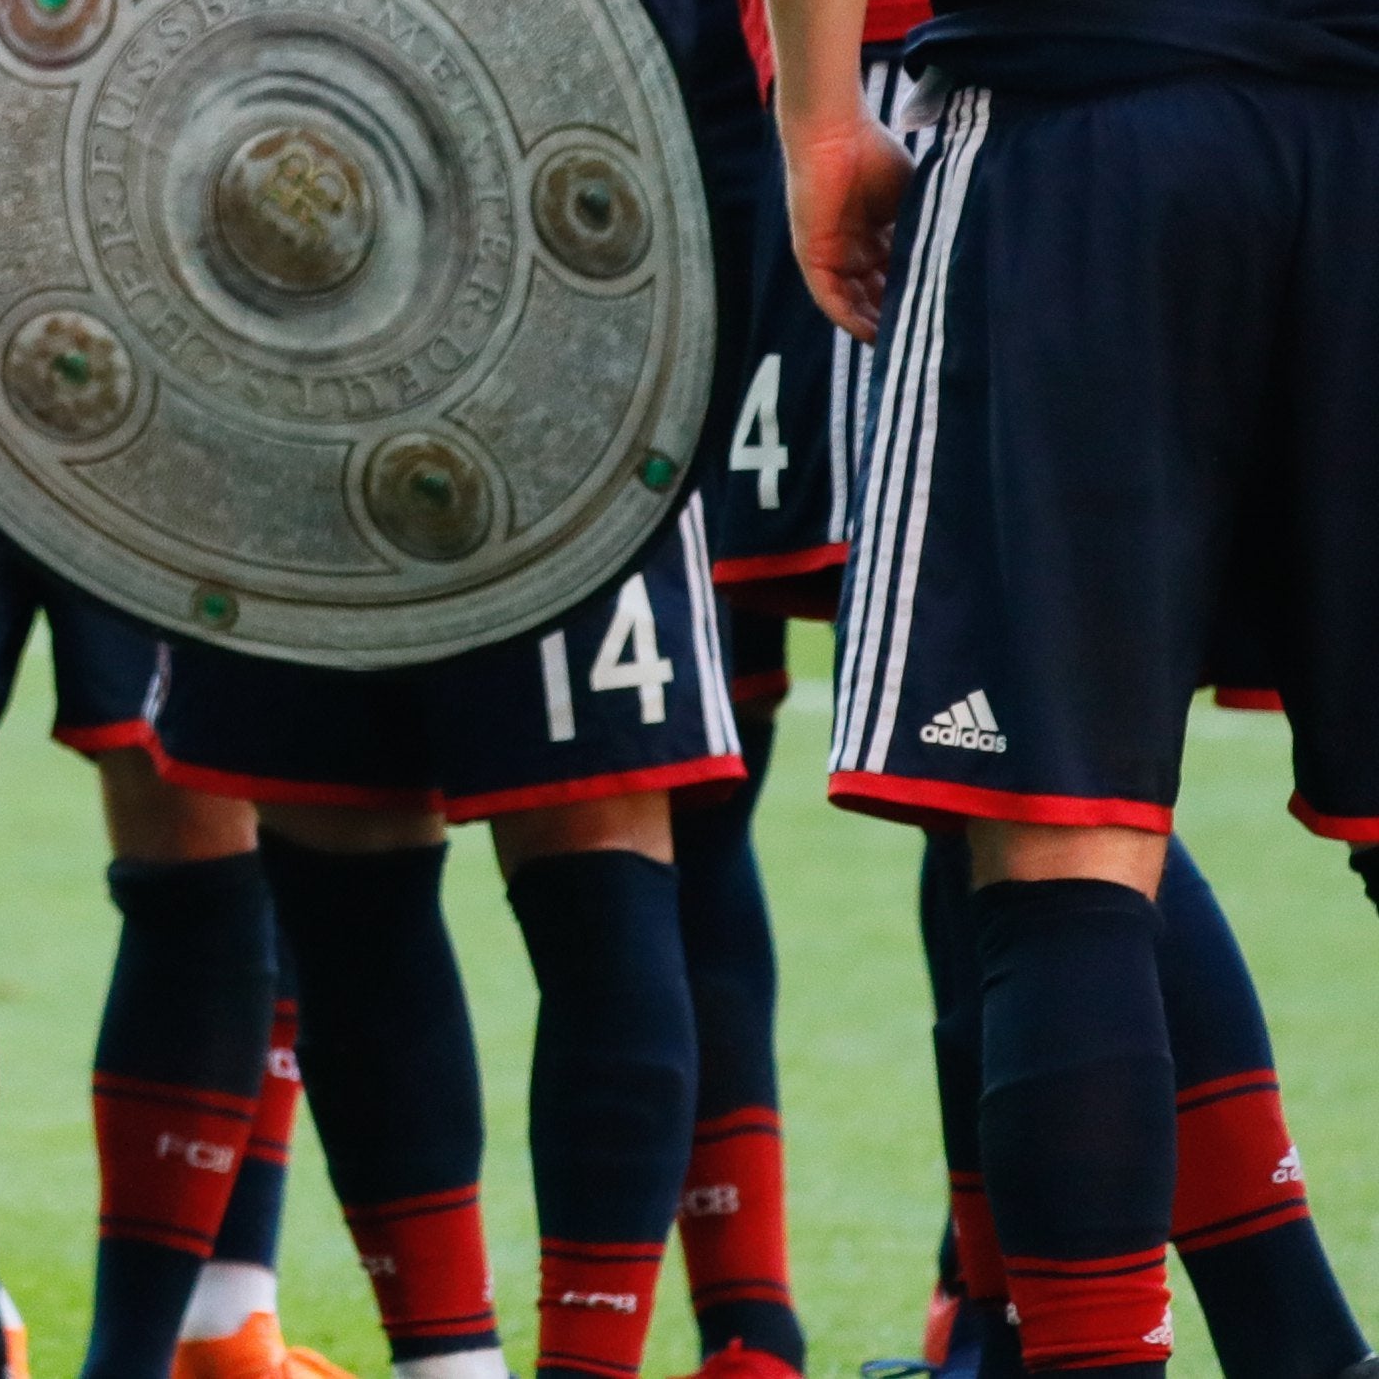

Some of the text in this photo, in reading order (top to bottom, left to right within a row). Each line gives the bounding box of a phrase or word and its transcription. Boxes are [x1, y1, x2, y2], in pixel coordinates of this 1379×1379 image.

[729, 353, 789, 510] 4
[539, 572, 674, 742] 14
[920, 723, 1007, 754] adidas
